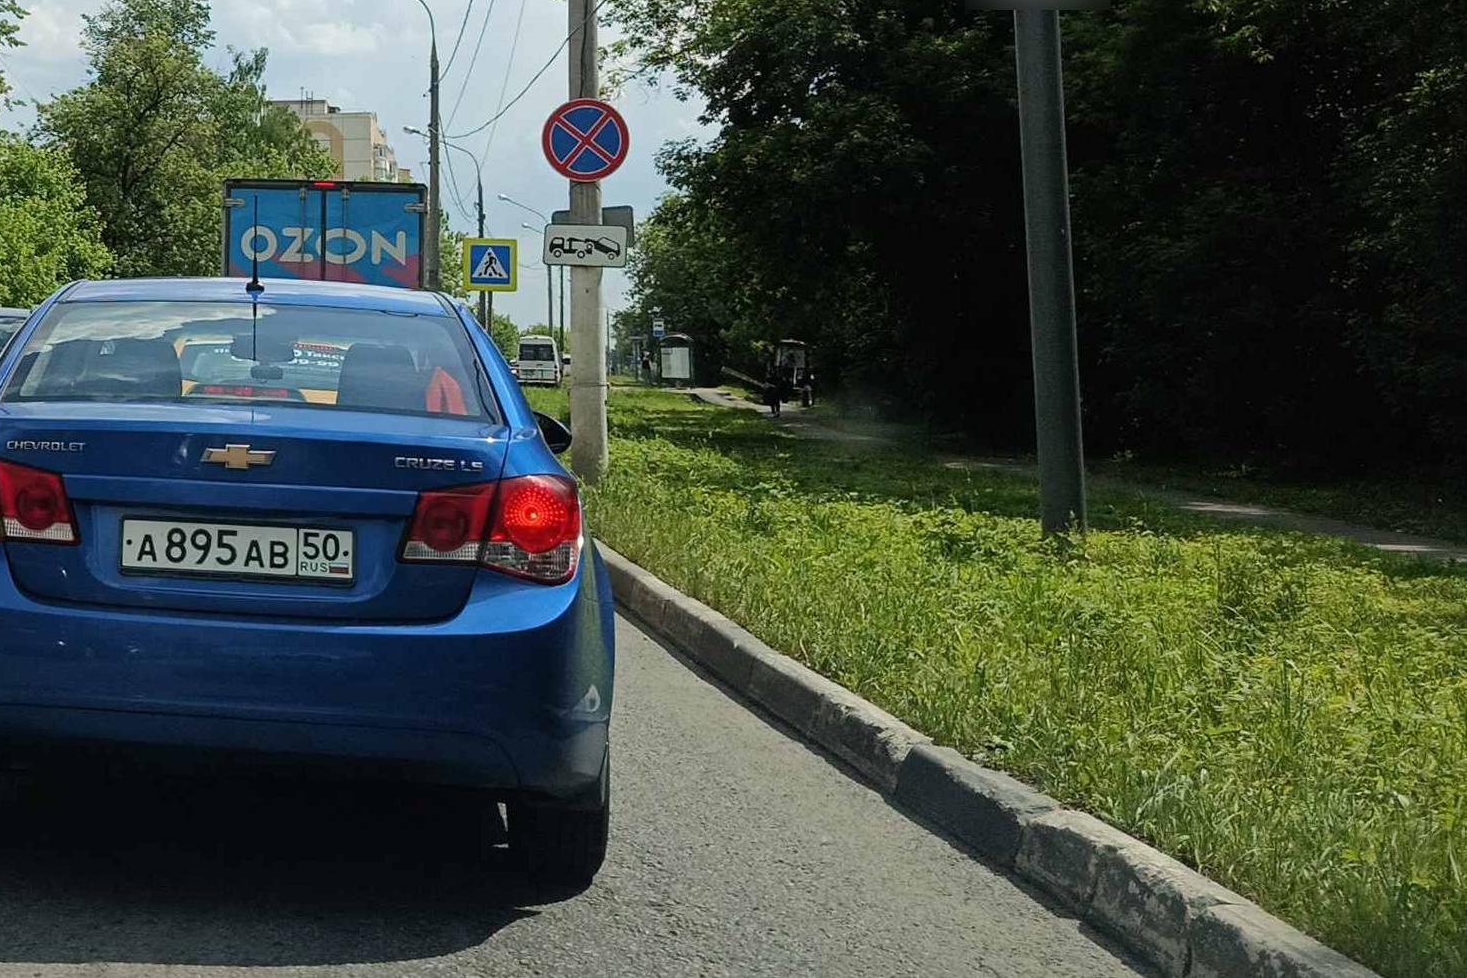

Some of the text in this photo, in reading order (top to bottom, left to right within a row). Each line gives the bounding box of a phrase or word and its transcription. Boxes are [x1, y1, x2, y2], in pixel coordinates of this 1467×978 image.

[240, 225, 407, 266] OZON
[6, 440, 86, 452] CHEVROLET
[394, 456, 455, 471] CRUZE
[302, 532, 341, 561] 50
[300, 562, 329, 572] RUS
